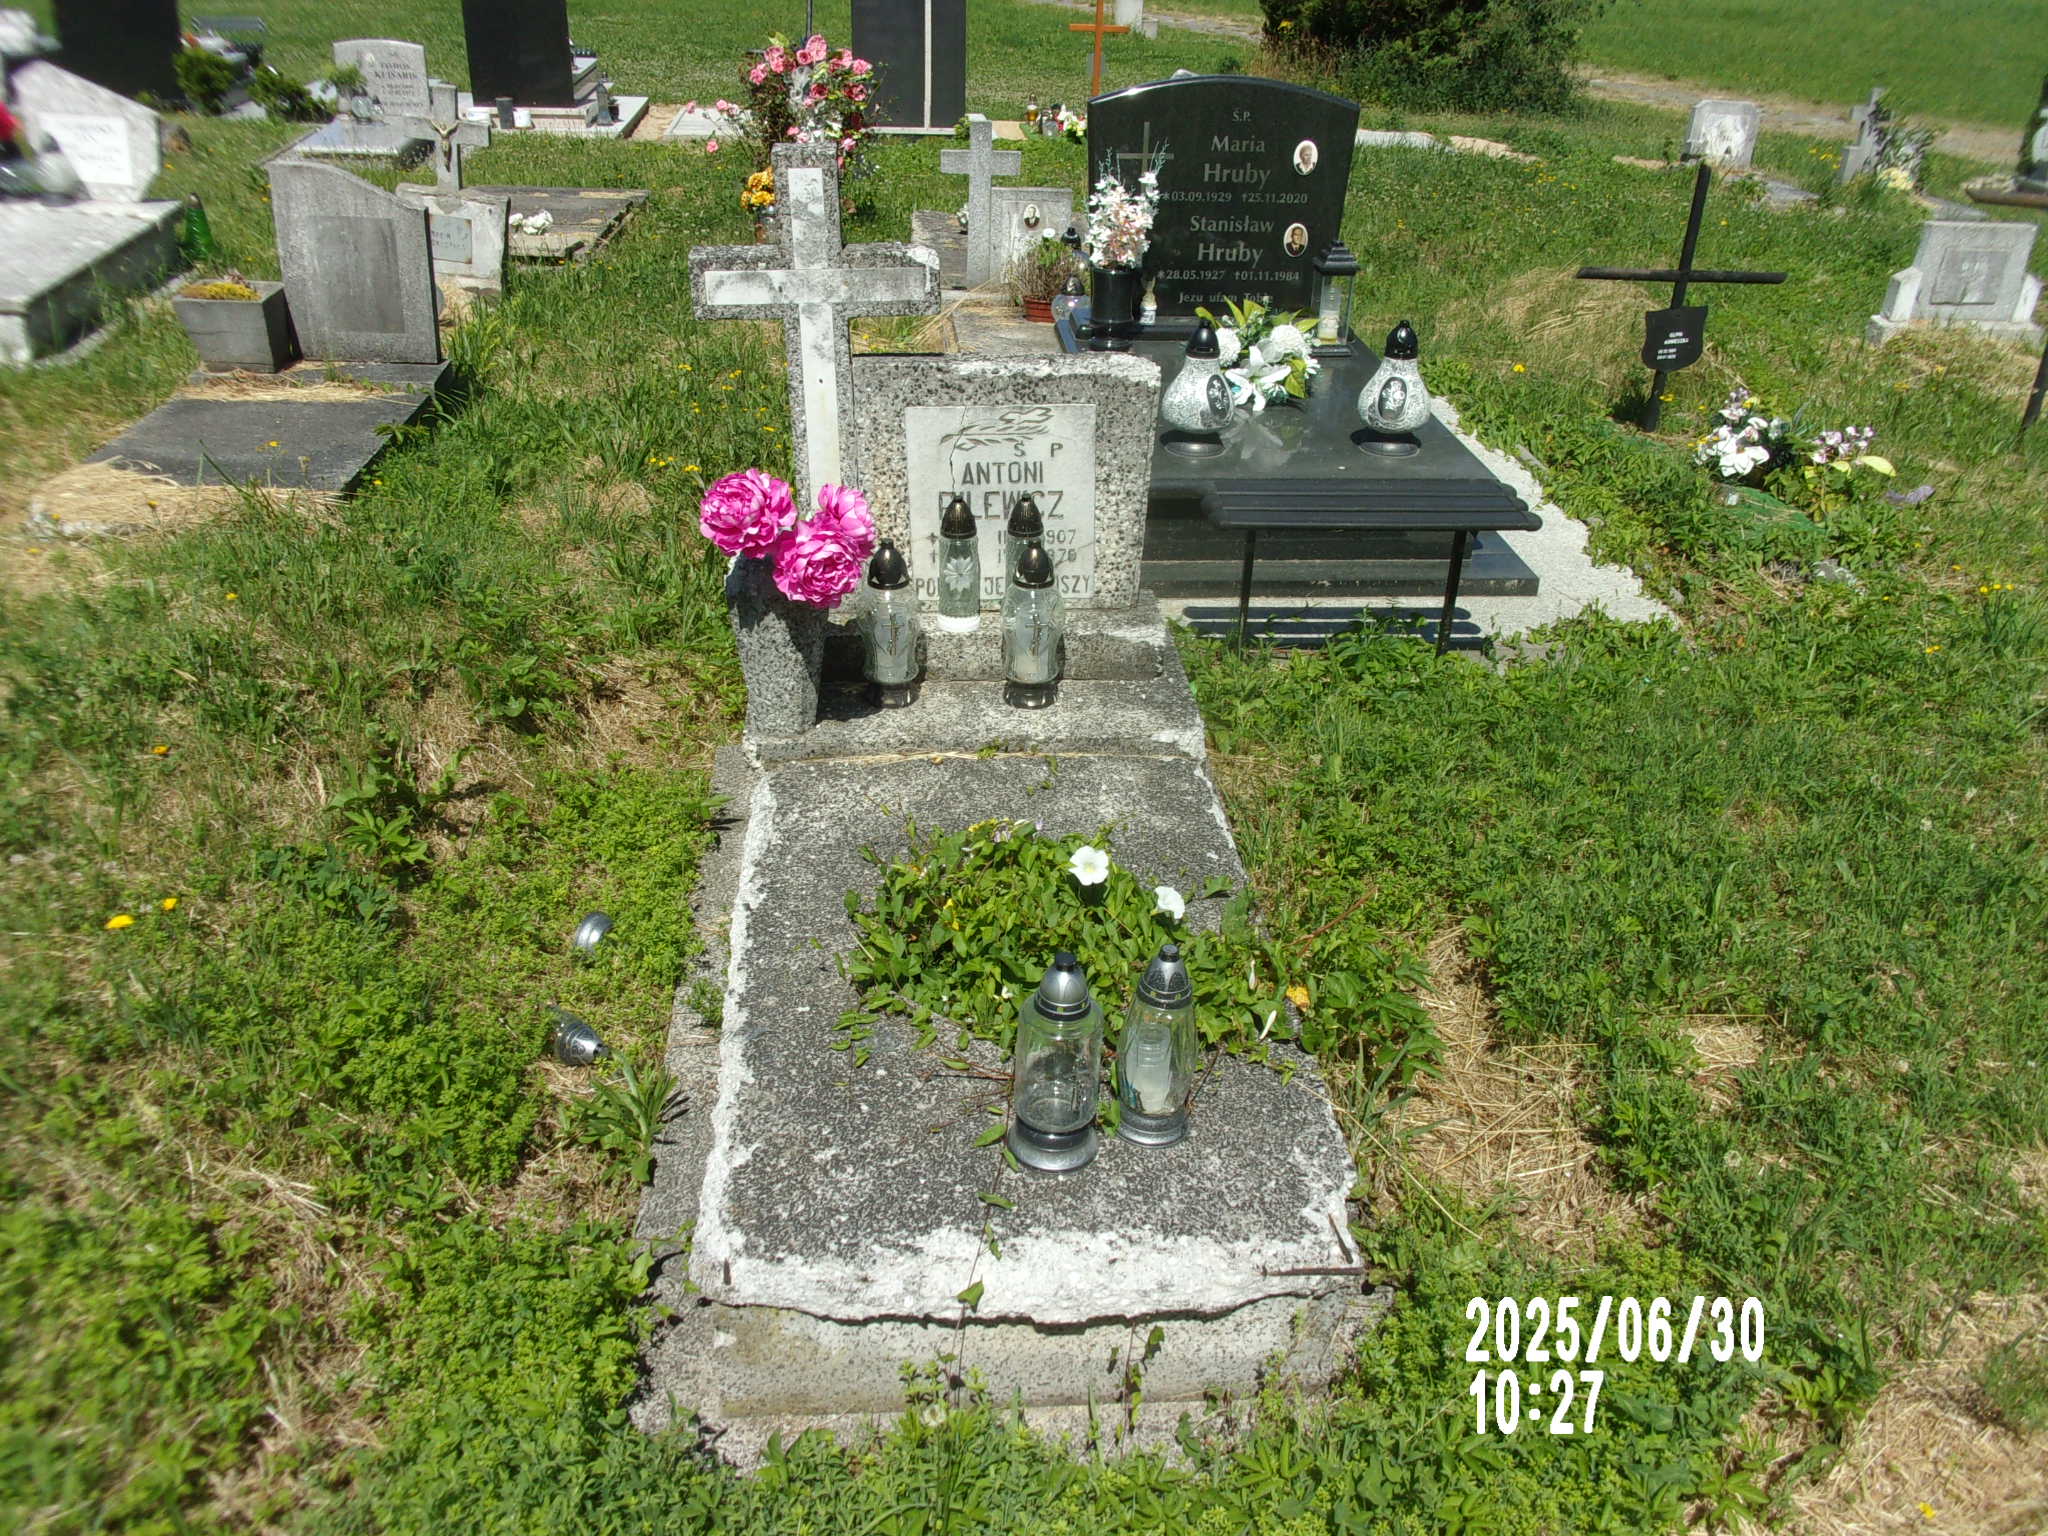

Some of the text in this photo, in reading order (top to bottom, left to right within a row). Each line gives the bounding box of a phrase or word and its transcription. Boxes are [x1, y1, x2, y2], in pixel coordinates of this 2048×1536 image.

[1211, 135, 1265, 153] Maria
[1203, 162, 1271, 189] Hruby
[1190, 214, 1274, 233] Stanisław
[1197, 242, 1263, 269] Hruby
[1178, 292, 1204, 304] Jezu
[1051, 443, 1063, 457] P
[961, 461, 1044, 485] ANTONI
